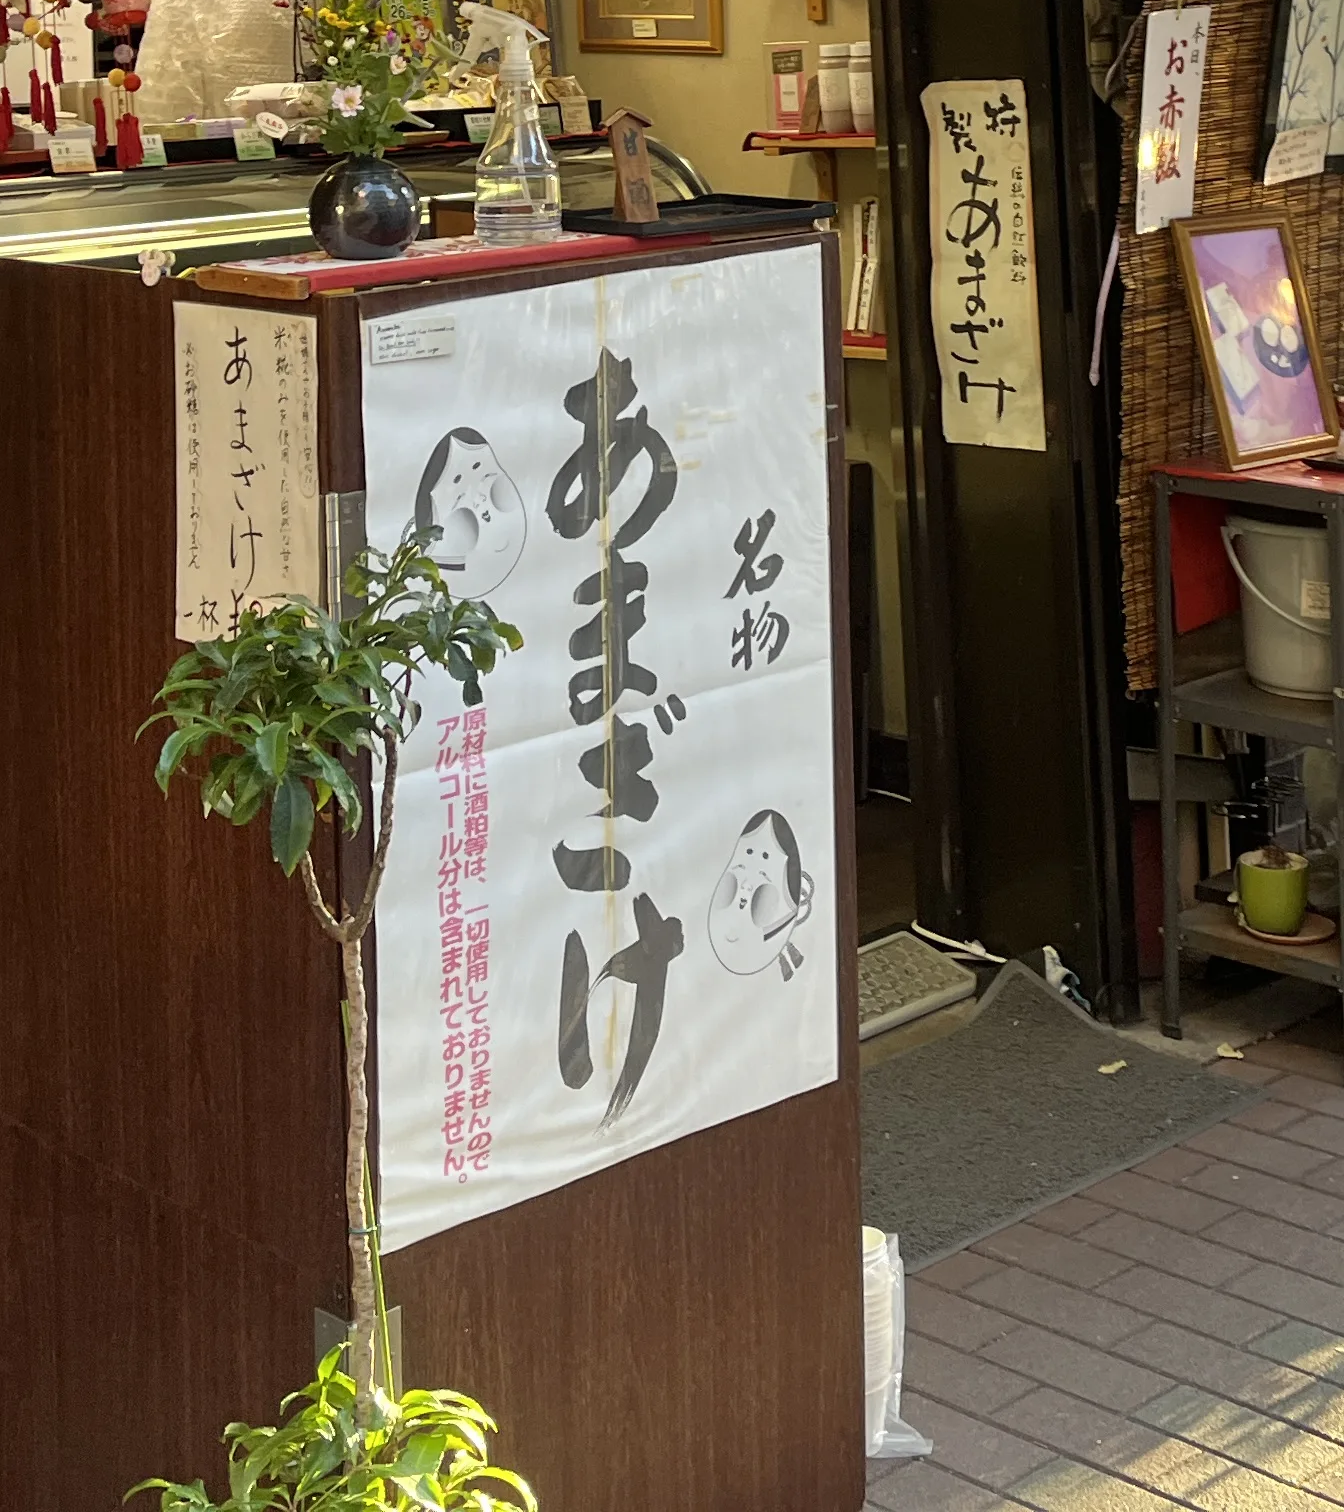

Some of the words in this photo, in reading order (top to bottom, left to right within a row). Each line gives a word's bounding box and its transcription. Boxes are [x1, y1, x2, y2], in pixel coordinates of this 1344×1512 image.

[946, 154, 1016, 424] あまざけ
[224, 326, 268, 589] あまざけ
[722, 507, 791, 671] 名物
[183, 594, 220, 634] 一杯
[545, 347, 687, 1138] あまざけ
[434, 716, 468, 1184] アルコール分は含まれておりません。
